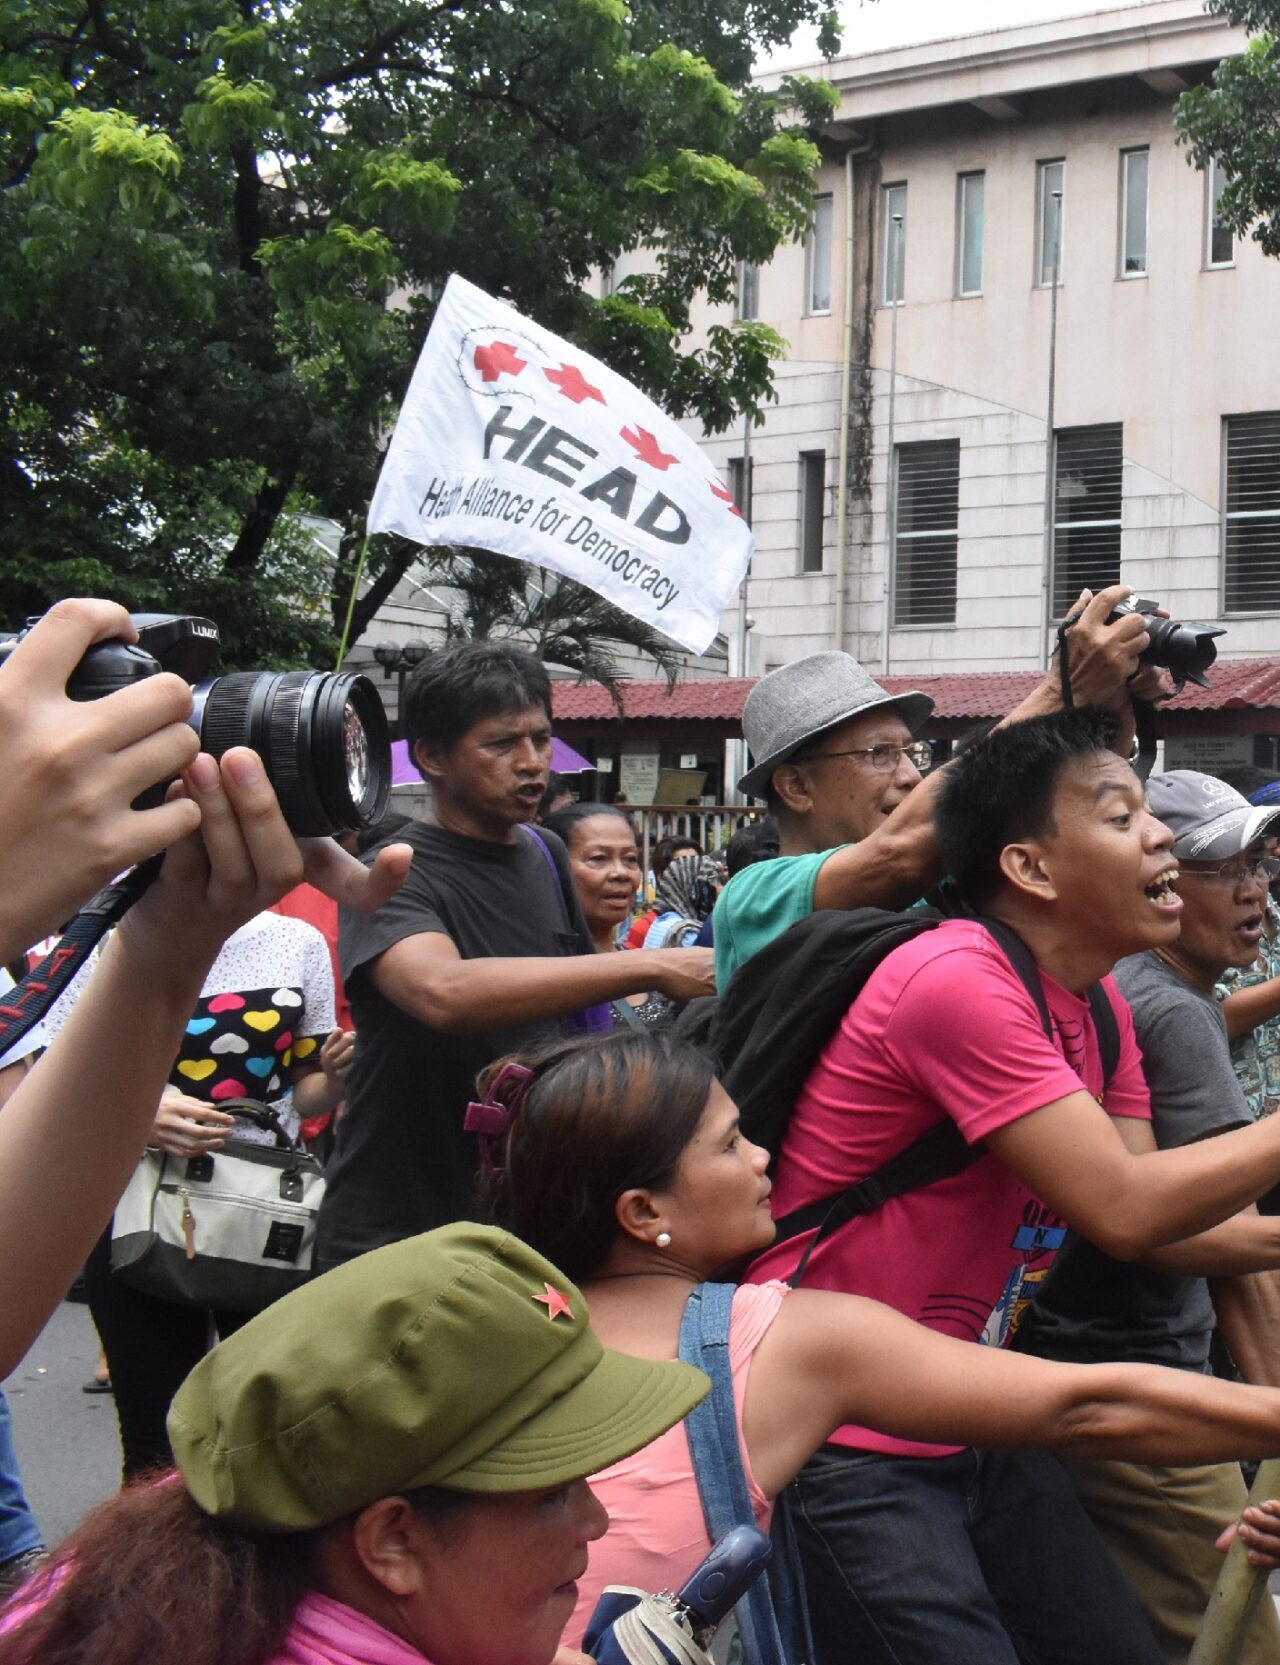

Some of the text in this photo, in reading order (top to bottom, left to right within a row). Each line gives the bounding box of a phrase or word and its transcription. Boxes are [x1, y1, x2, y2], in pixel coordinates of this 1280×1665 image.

[457, 476, 534, 524] Alliance
[529, 496, 571, 536] for
[564, 515, 680, 611] Democracy
[482, 405, 692, 545] HEAD
